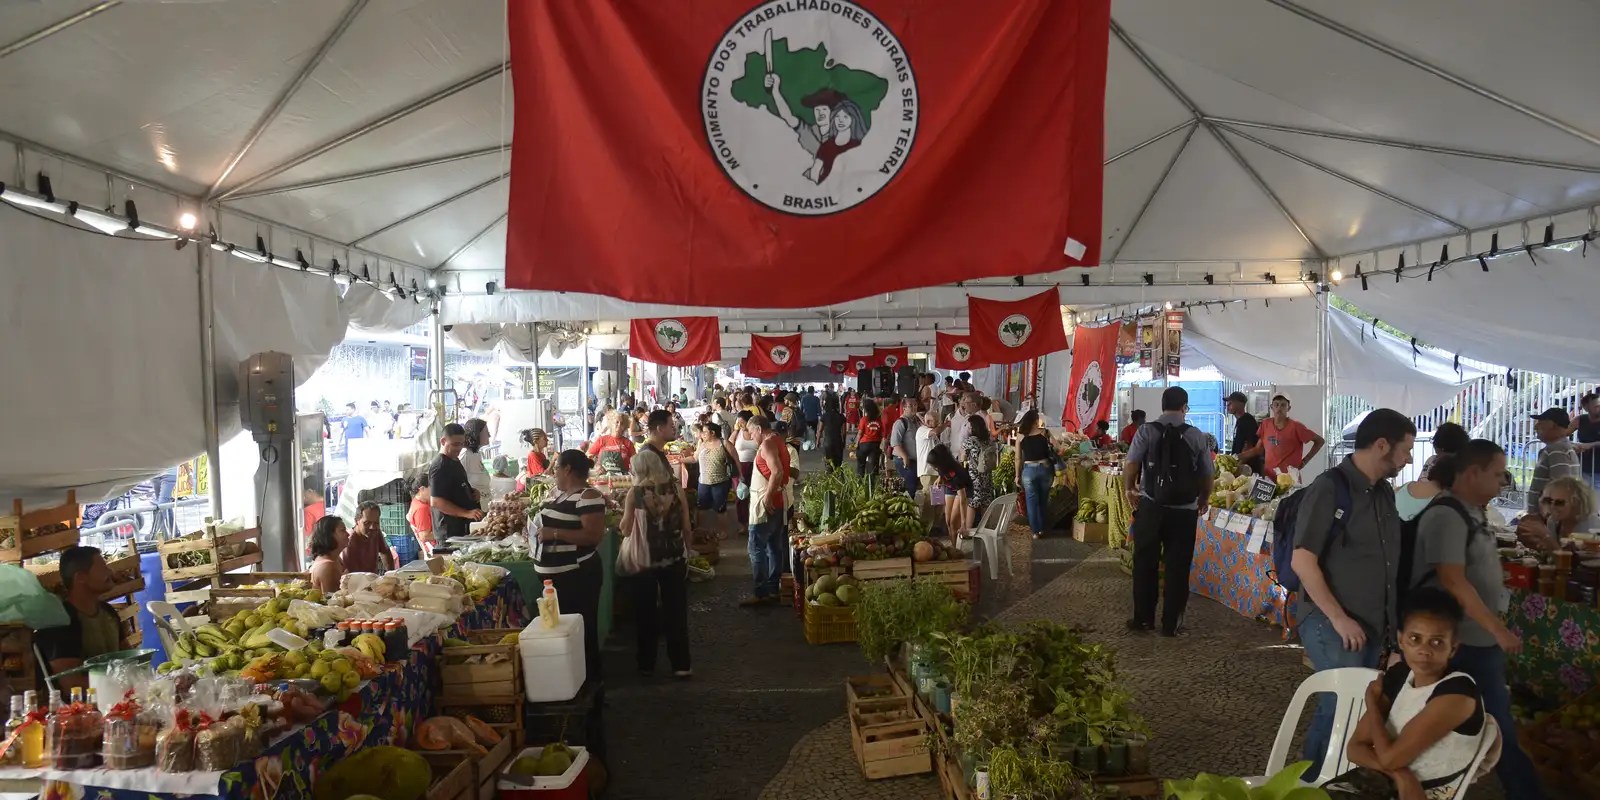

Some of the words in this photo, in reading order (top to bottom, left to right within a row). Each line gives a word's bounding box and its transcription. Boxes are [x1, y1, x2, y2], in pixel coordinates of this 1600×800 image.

[735, 0, 872, 39] TRABALHADORES
[714, 40, 737, 72] DOS
[872, 27, 910, 83] RURAIS
[704, 76, 741, 170] MOVIMENTO
[901, 88, 914, 121] SEM
[879, 128, 914, 175] TERRA
[783, 194, 838, 209] BRASIL
